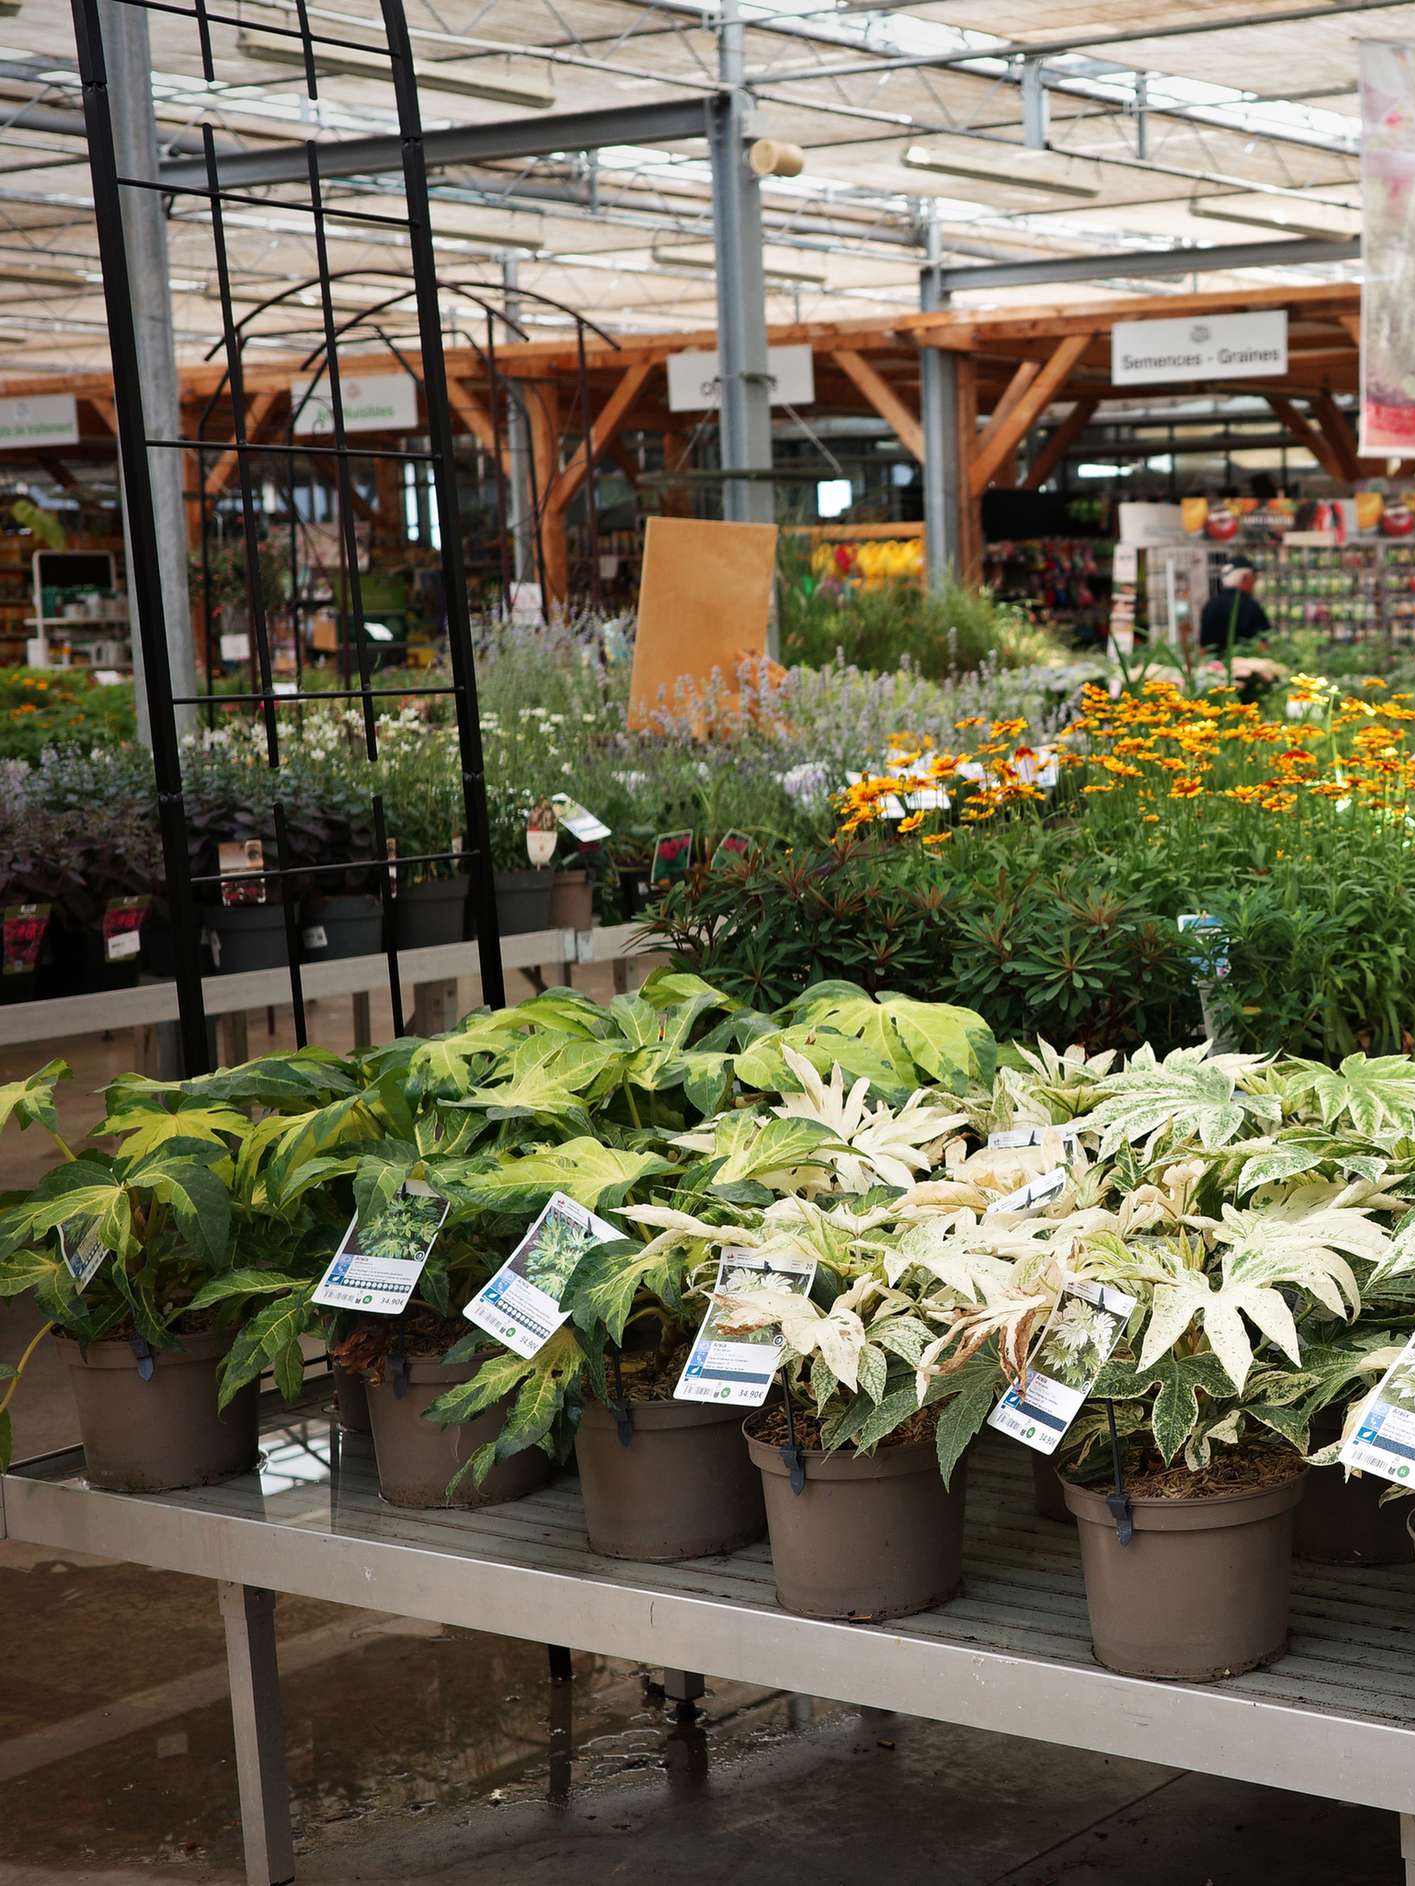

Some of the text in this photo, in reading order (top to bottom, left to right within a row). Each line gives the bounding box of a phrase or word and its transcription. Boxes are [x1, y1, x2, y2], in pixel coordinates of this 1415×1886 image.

[1121, 353, 1203, 371] Semences
[1217, 346, 1281, 366] Graines
[380, 1297, 405, 1306] 34.90€
[737, 1387, 765, 1400] 34.90€
